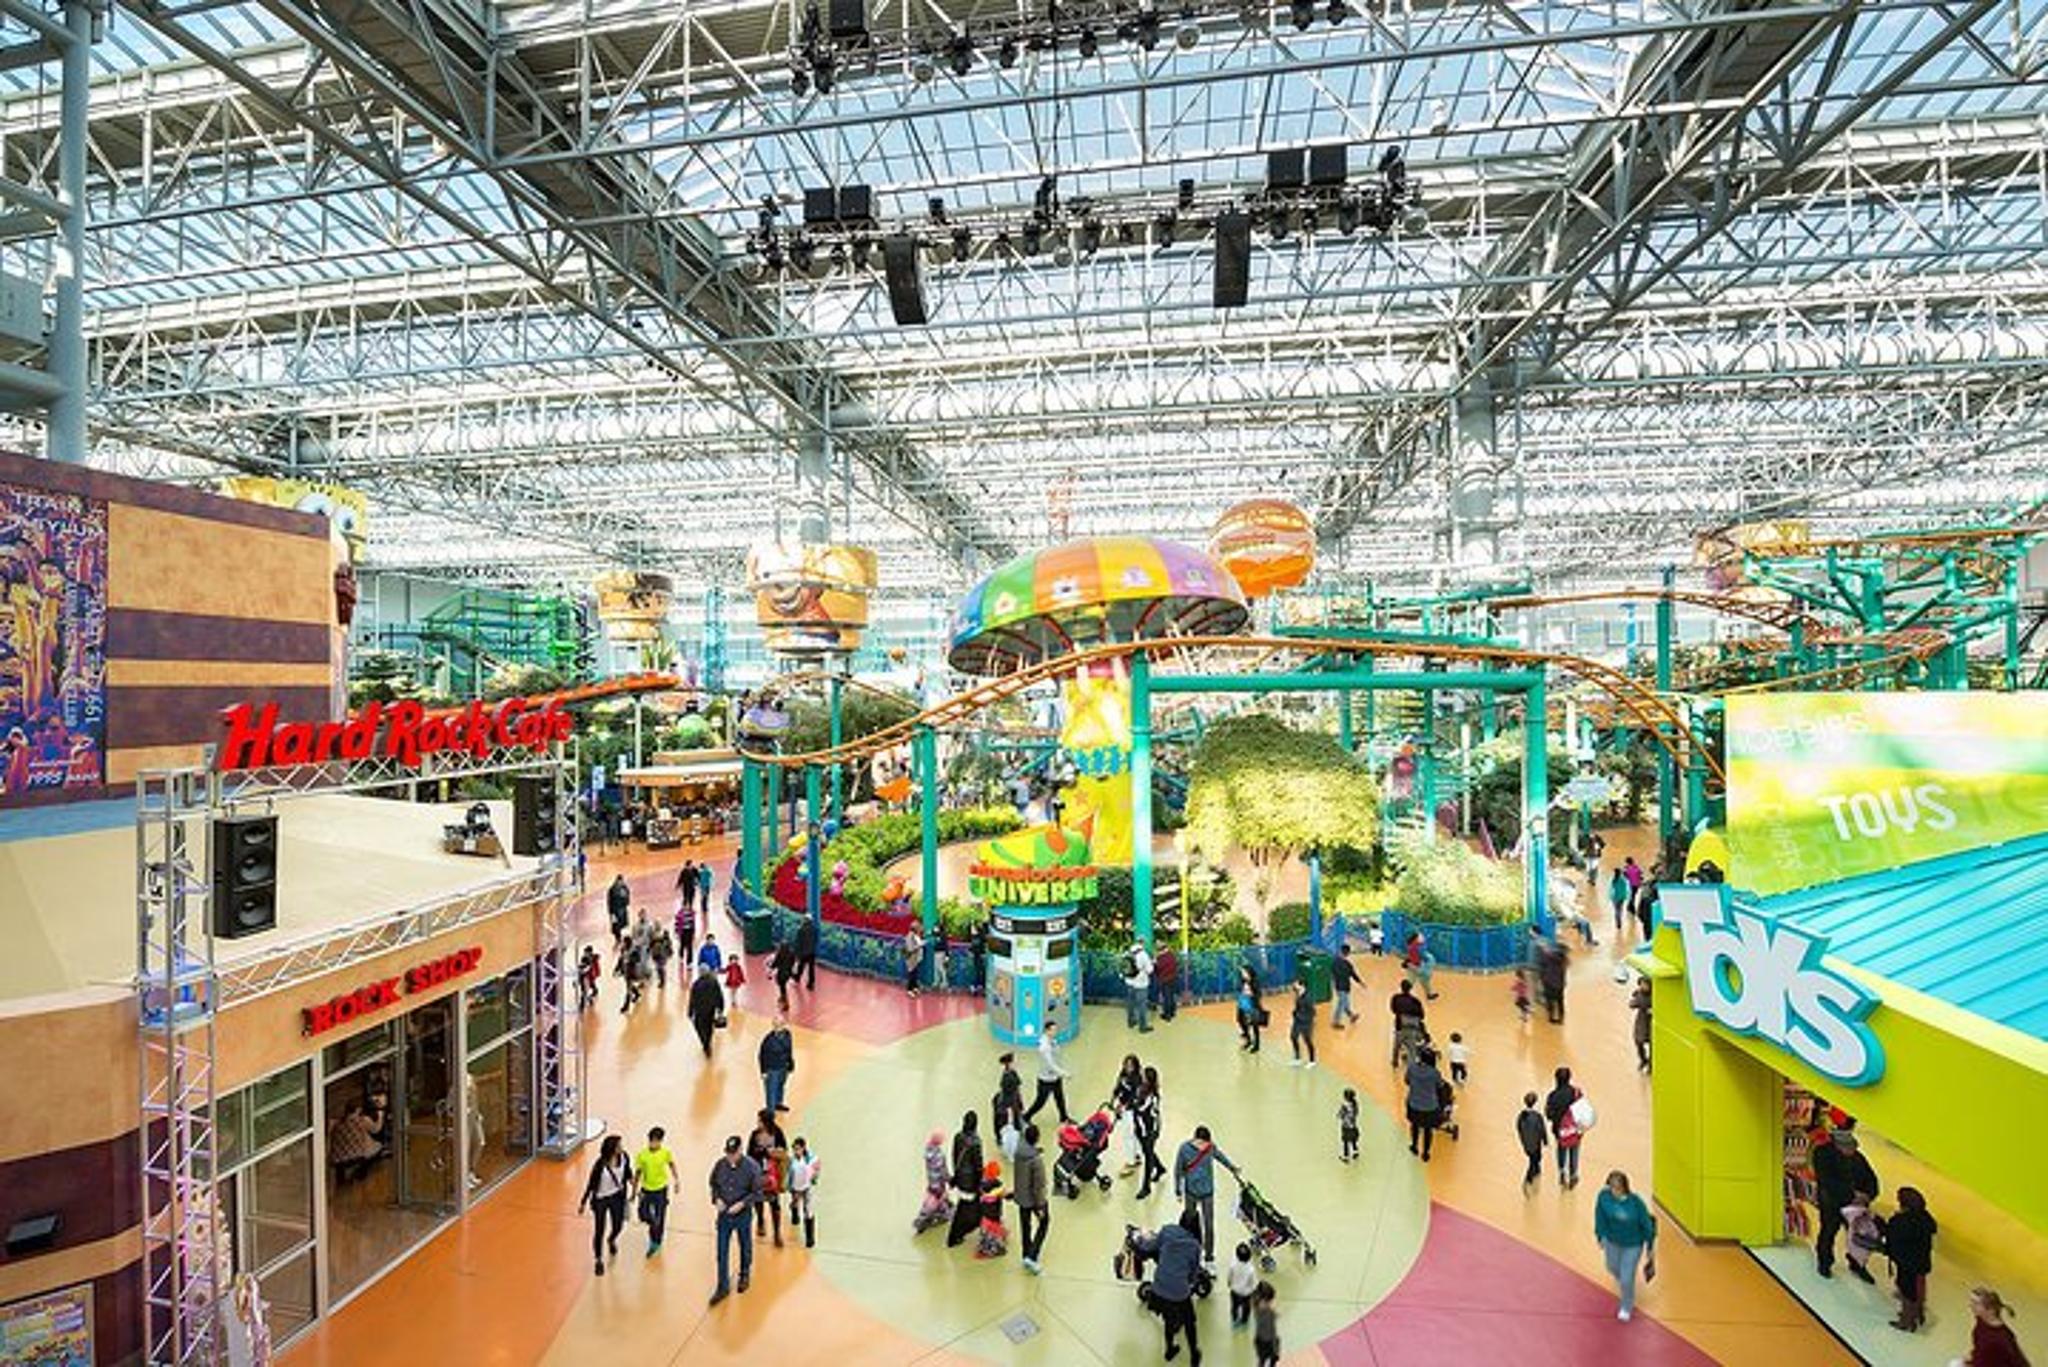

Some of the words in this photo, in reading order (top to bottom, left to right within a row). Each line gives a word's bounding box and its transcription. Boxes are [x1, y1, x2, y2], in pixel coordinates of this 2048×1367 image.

[219, 699, 384, 770] Hard
[386, 698, 492, 767] Rock
[496, 697, 573, 752] Cafe
[1815, 783, 1957, 841] TOYS
[968, 875, 1100, 906] UNIVERSE
[302, 976, 402, 1037] ROCK
[404, 945, 483, 994] SHOP
[1656, 884, 1882, 1085] TOYS
